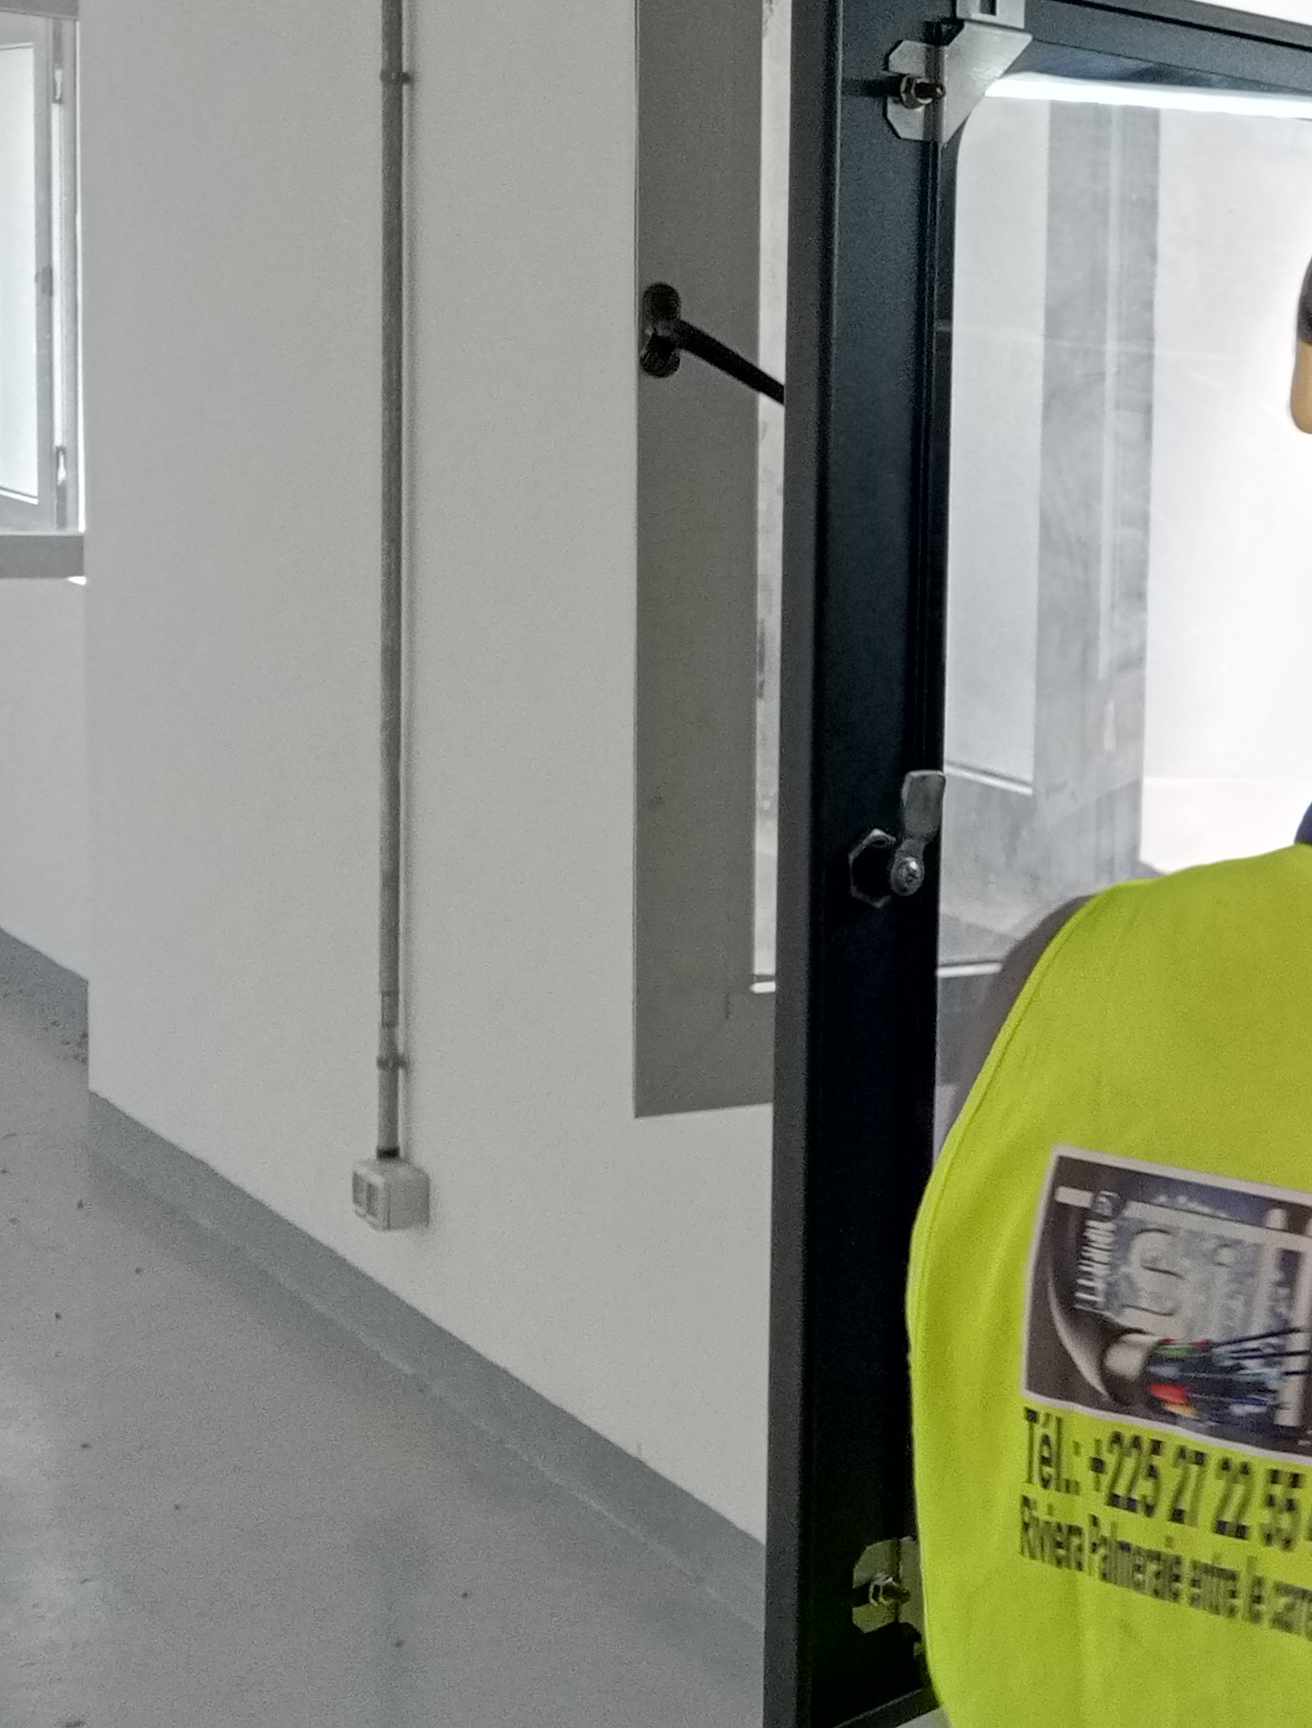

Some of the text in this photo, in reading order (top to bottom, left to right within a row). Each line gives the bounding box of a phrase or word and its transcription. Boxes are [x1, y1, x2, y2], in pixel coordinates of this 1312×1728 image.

[1088, 1430, 1163, 1517] +225
[1168, 1445, 1207, 1527] 27
[1213, 1456, 1253, 1540] 22
[1259, 1467, 1305, 1552] 55
[1020, 1495, 1084, 1572] Riviera
[1087, 1512, 1184, 1602] Palmeraie
[1188, 1554, 1240, 1619] entre
[1243, 1555, 1265, 1624] le
